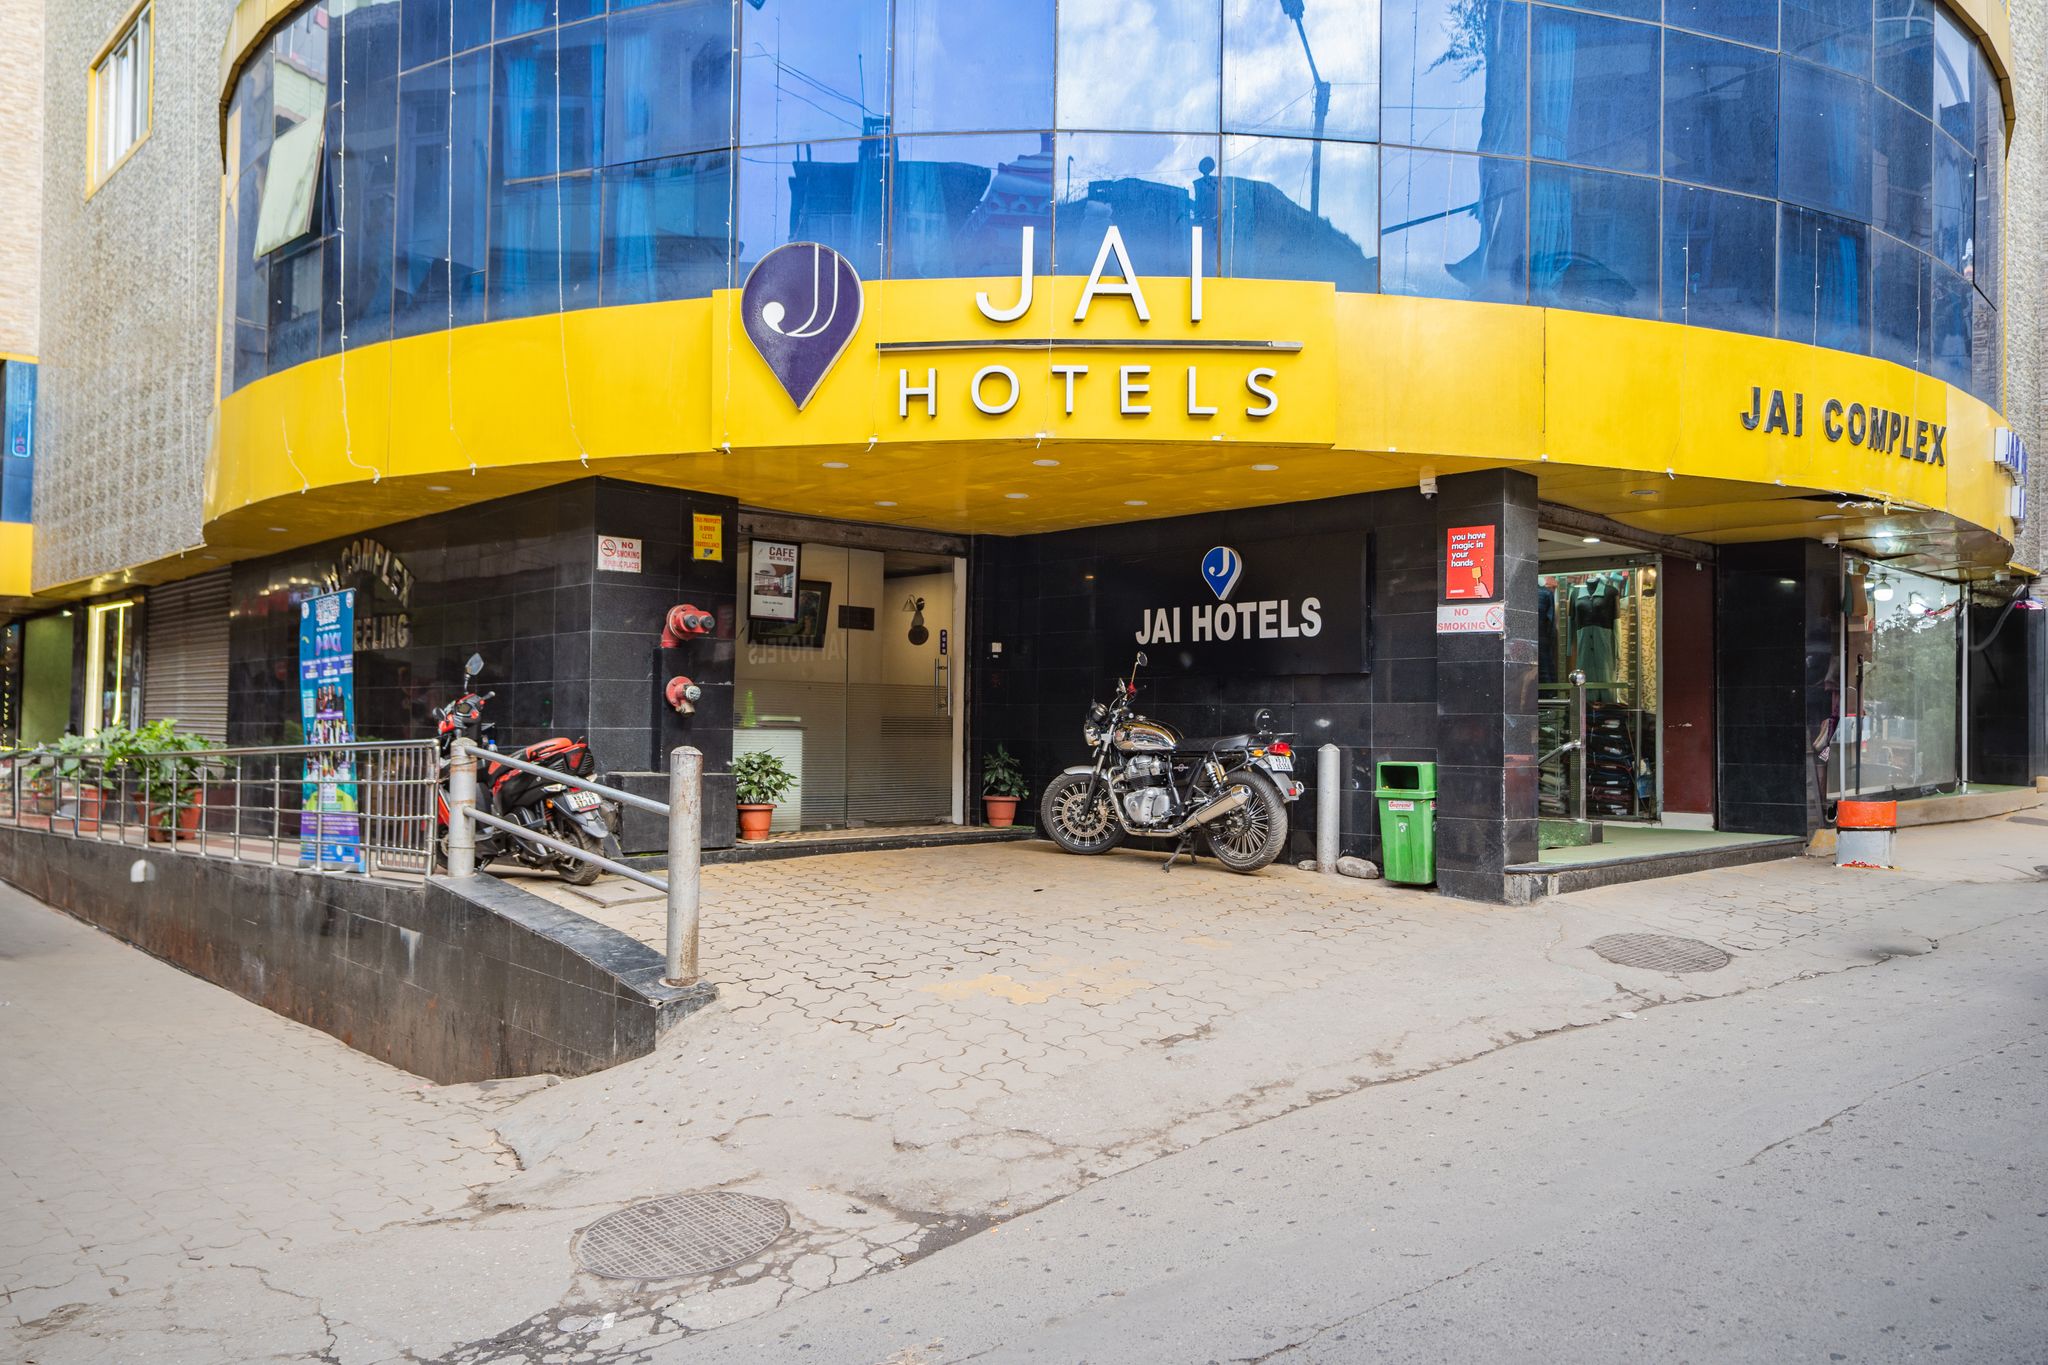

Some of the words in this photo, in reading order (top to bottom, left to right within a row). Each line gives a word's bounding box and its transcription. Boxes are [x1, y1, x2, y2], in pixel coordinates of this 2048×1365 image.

[975, 224, 1203, 323] JAI
[899, 364, 1280, 417] HOTELS
[1740, 386, 1803, 437] JAI
[1822, 398, 1947, 467] COMPLEX
[1451, 534, 1466, 543] you
[1467, 532, 1486, 540] have
[621, 541, 634, 550] NO
[1451, 541, 1474, 551] magic
[1476, 540, 1483, 548] in
[616, 550, 640, 559] SMOKING
[769, 546, 795, 558] CAFE
[1451, 551, 1469, 560] your
[1450, 559, 1474, 568] hands
[341, 538, 415, 609] COMPLEX
[1454, 608, 1469, 617] NO
[1135, 607, 1181, 645] JAI
[1191, 597, 1322, 642] HOTELS
[1437, 621, 1486, 631] SMOKING
[353, 614, 408, 651] EELING
